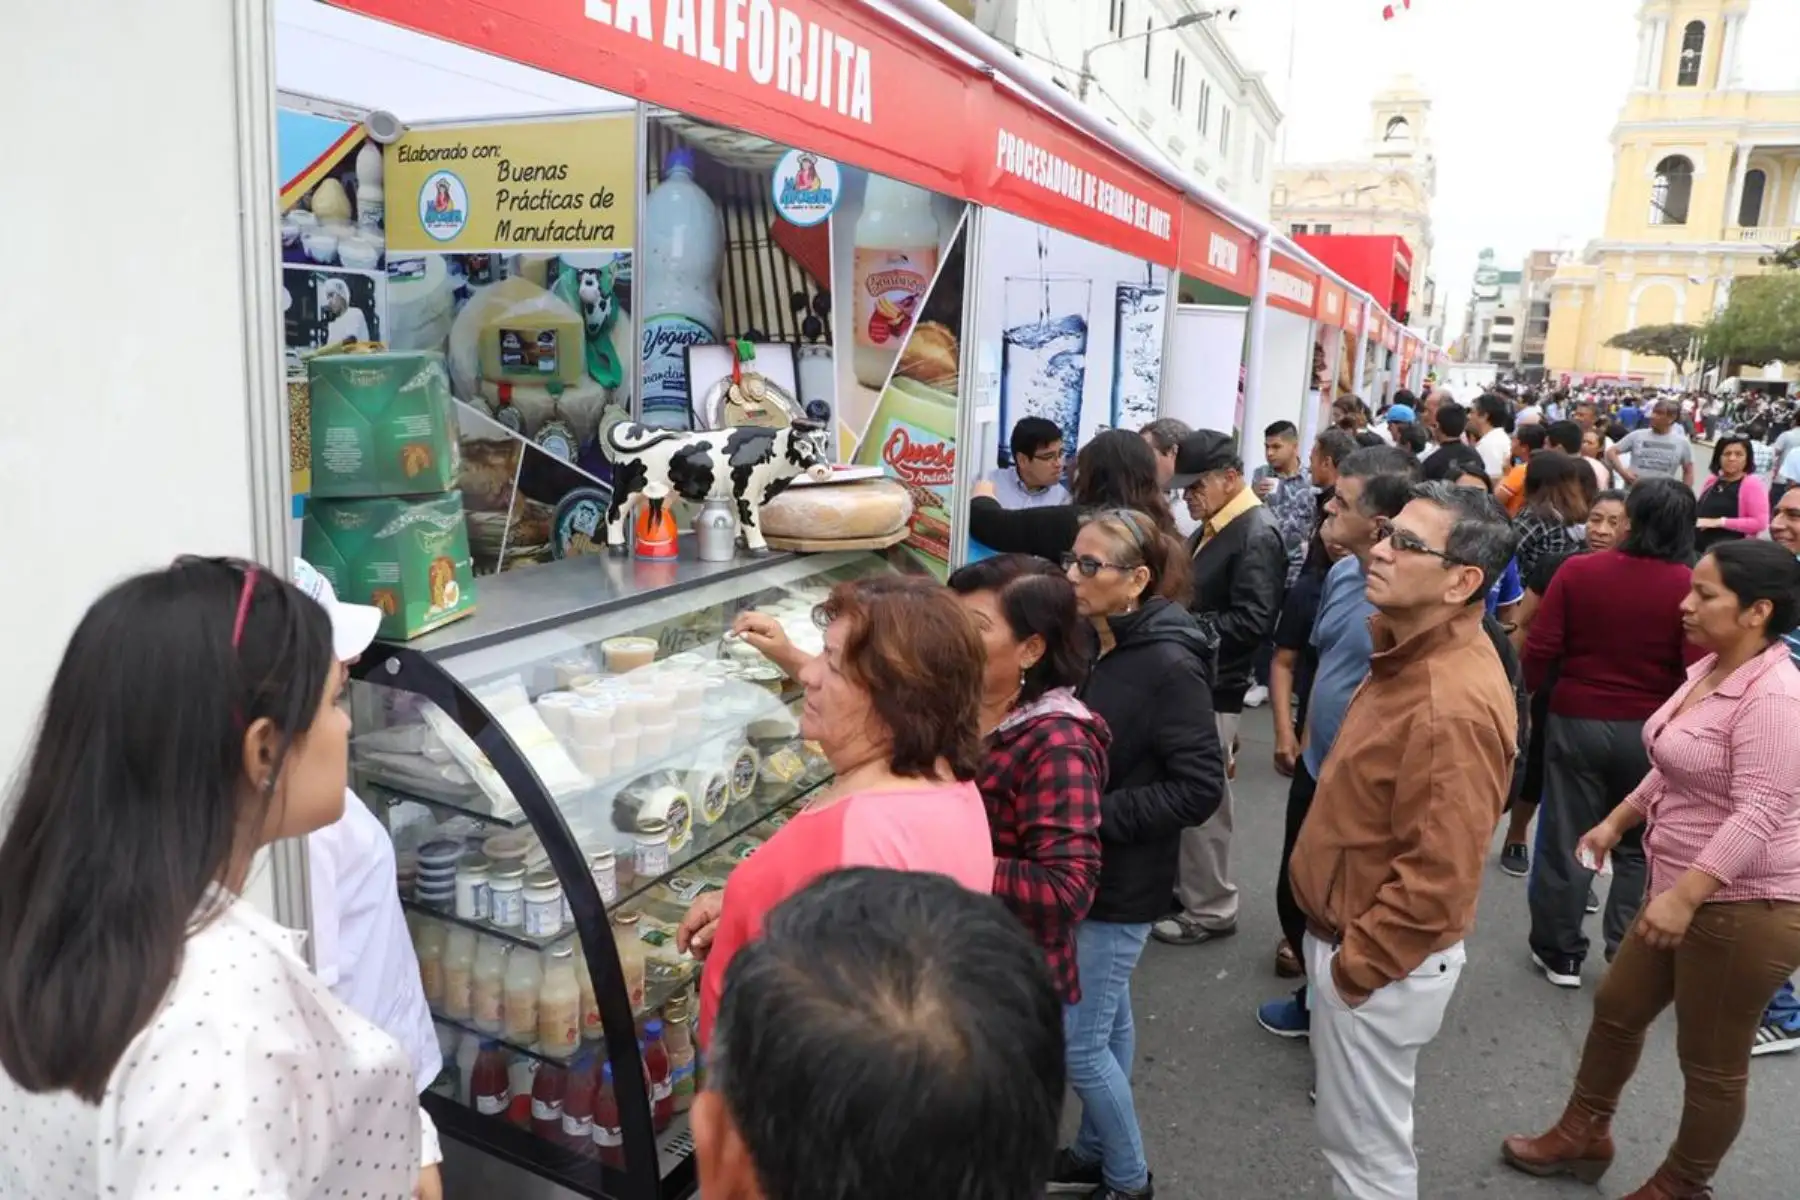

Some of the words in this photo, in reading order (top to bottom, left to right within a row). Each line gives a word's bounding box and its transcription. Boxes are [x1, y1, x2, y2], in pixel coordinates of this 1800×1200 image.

[663, 0, 872, 124] ALFORJITA
[398, 142, 467, 163] Elaborado
[472, 144, 502, 159] con:
[997, 128, 1082, 203] PROCESADORA
[497, 159, 568, 182] Buenas
[495, 188, 584, 212] Prácticas
[589, 185, 614, 209] de
[494, 218, 615, 242] Manufactura
[643, 325, 706, 360] Yogurt
